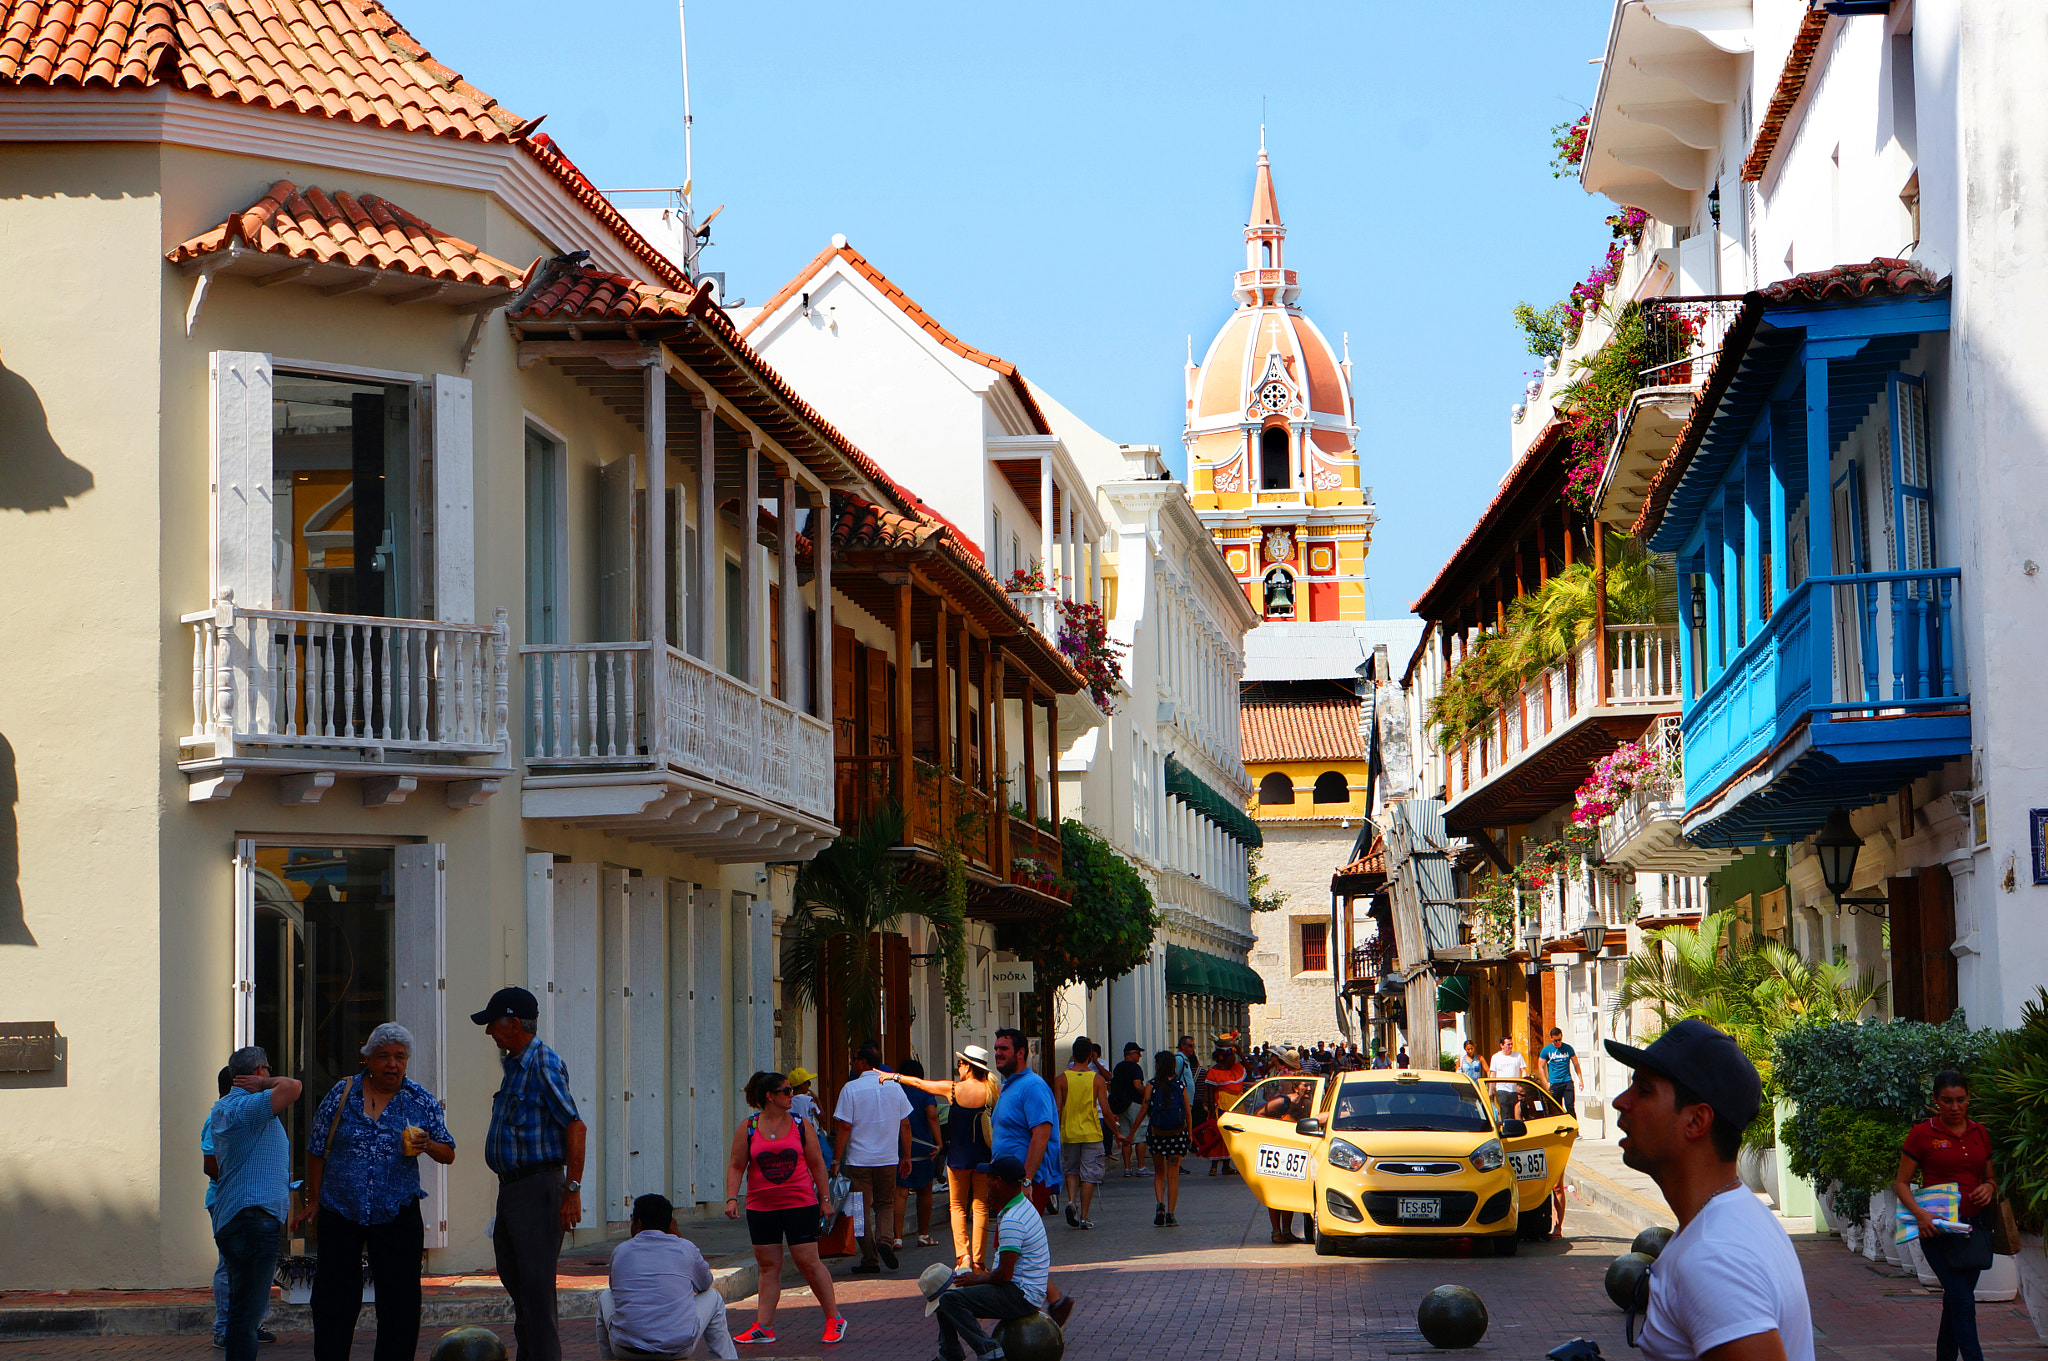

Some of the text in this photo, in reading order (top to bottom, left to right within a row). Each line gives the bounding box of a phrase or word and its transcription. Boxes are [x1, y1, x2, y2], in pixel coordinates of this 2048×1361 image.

[1260, 1149, 1307, 1173] TES 857
[1508, 1153, 1544, 1175] ES 857
